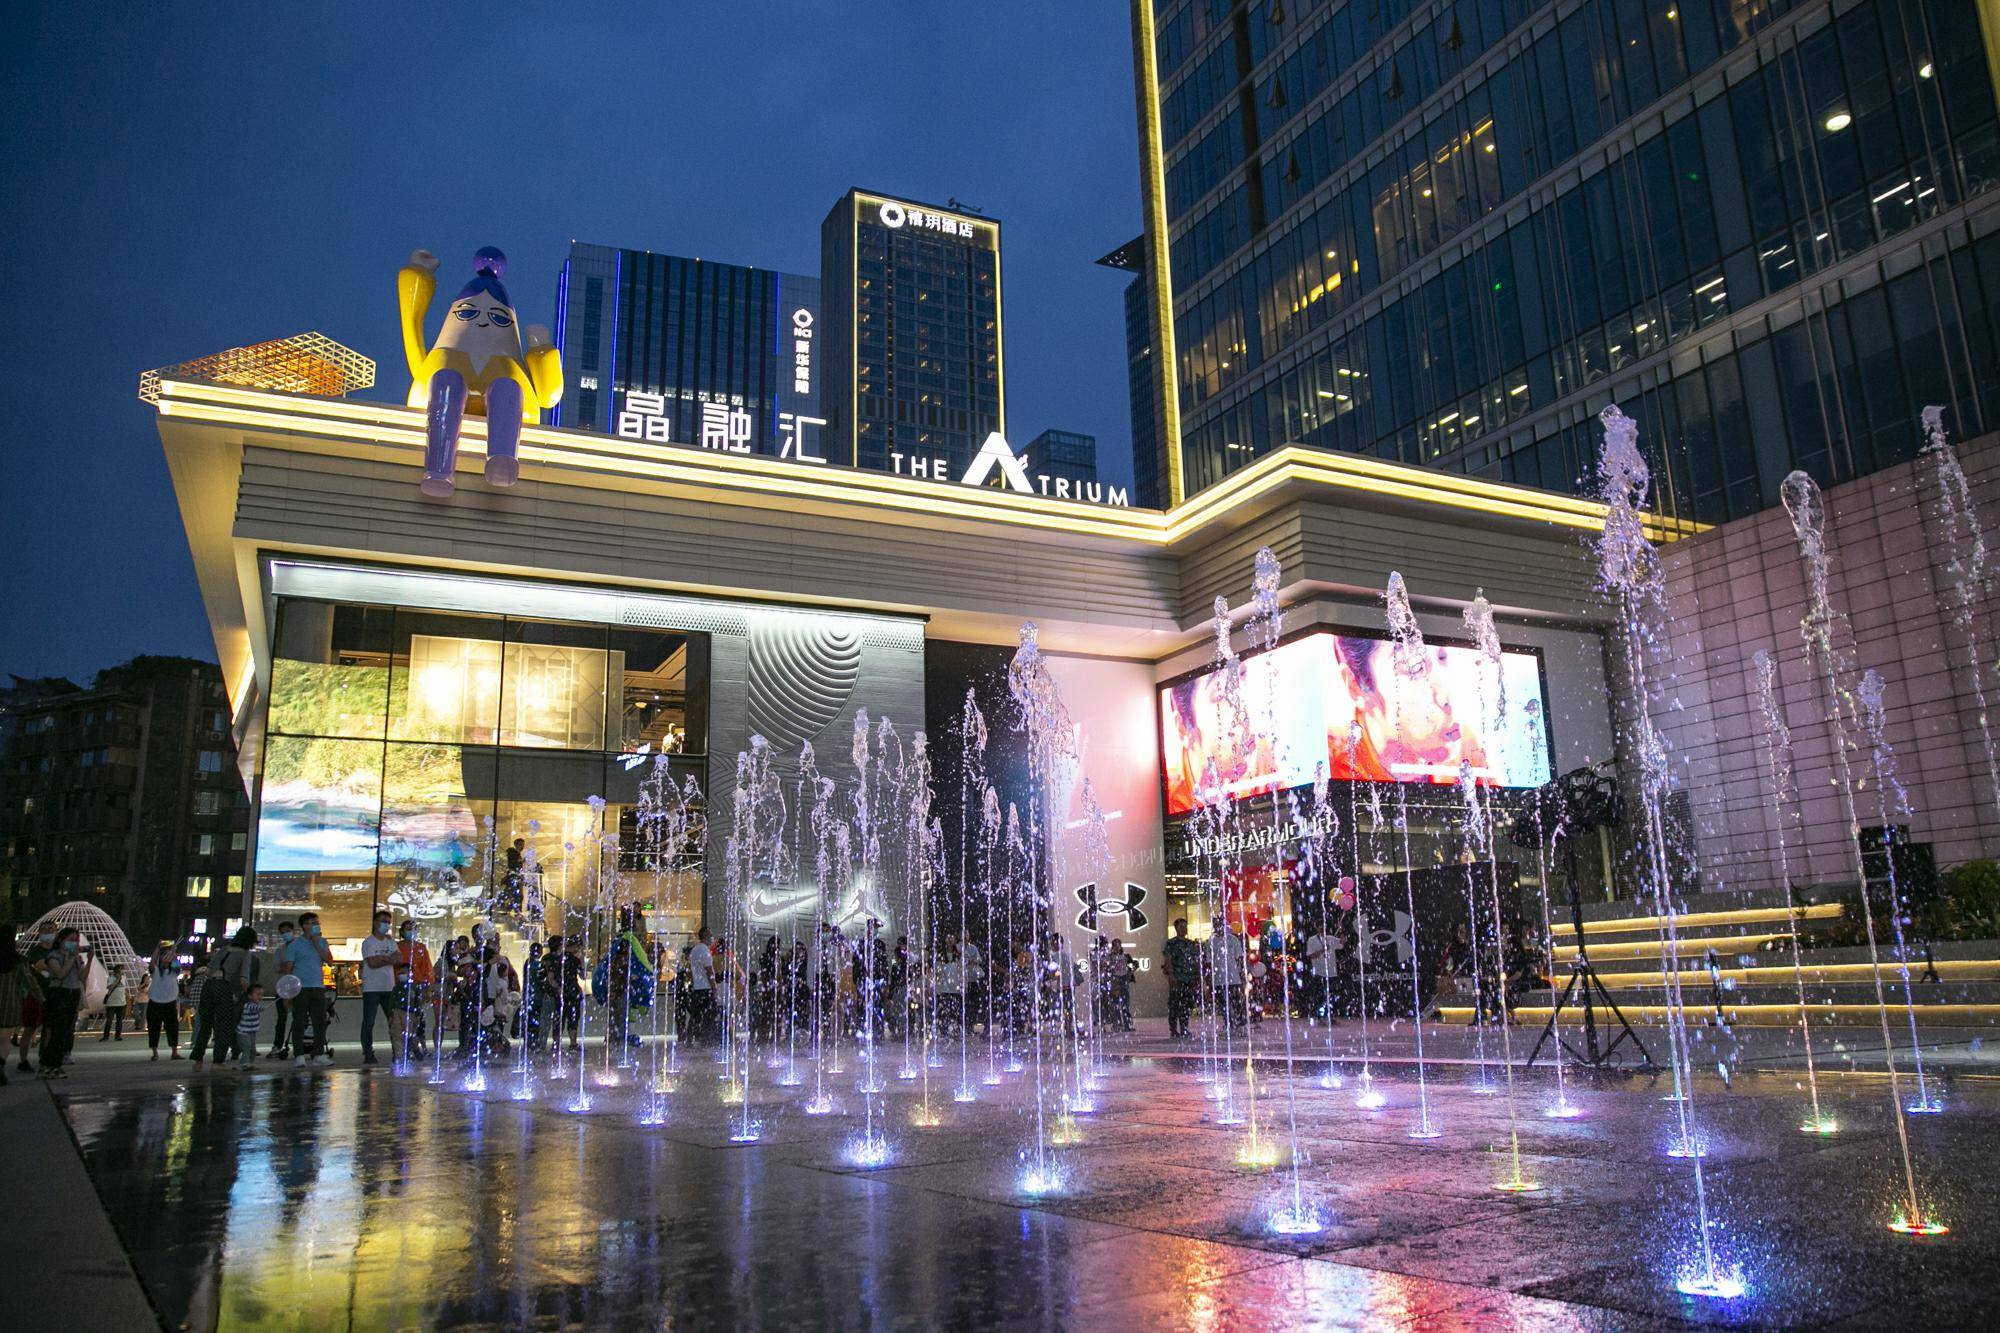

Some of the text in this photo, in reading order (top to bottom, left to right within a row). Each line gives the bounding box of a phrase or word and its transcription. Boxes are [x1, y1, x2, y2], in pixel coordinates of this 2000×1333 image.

[618, 390, 828, 465] 晶融汇
[890, 431, 1129, 508] THE ATRIUM
